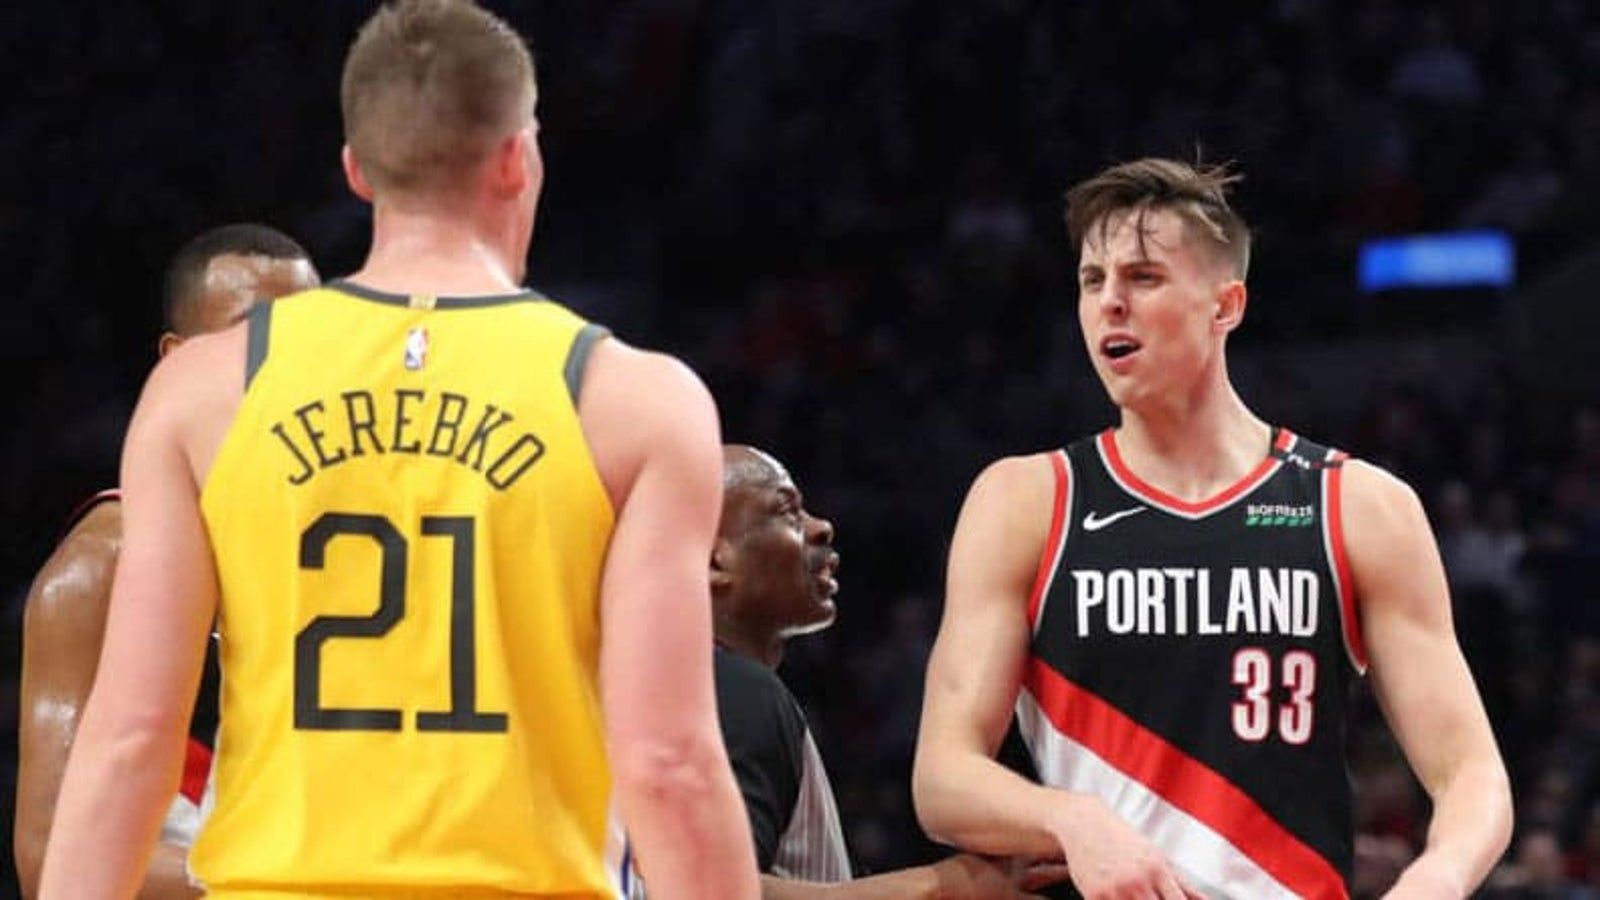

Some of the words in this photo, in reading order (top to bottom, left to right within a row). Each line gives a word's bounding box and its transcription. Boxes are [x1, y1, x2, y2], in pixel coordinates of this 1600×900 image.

[271, 389, 546, 491] JEREBKO
[293, 511, 510, 734] 21
[1071, 567, 1319, 638] PORTLAND
[1230, 646, 1317, 745] 33
